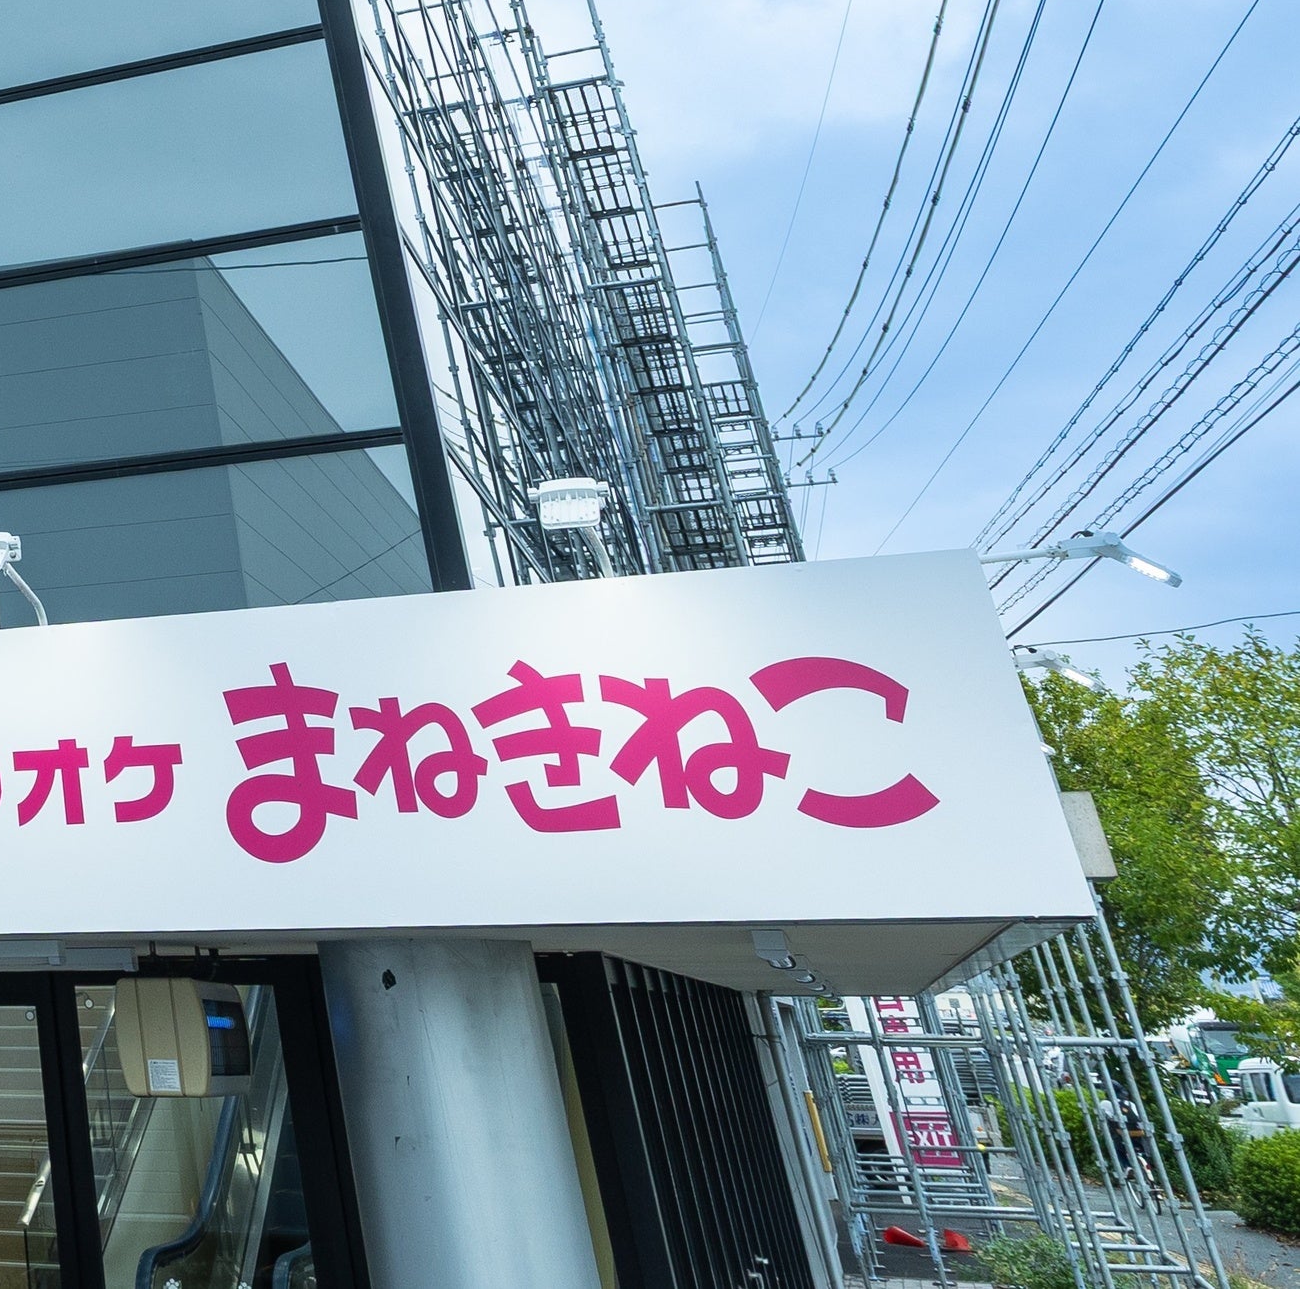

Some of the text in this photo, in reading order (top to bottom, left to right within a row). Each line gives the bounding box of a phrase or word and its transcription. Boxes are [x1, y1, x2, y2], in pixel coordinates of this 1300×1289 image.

[222, 656, 941, 864] まねきねこ
